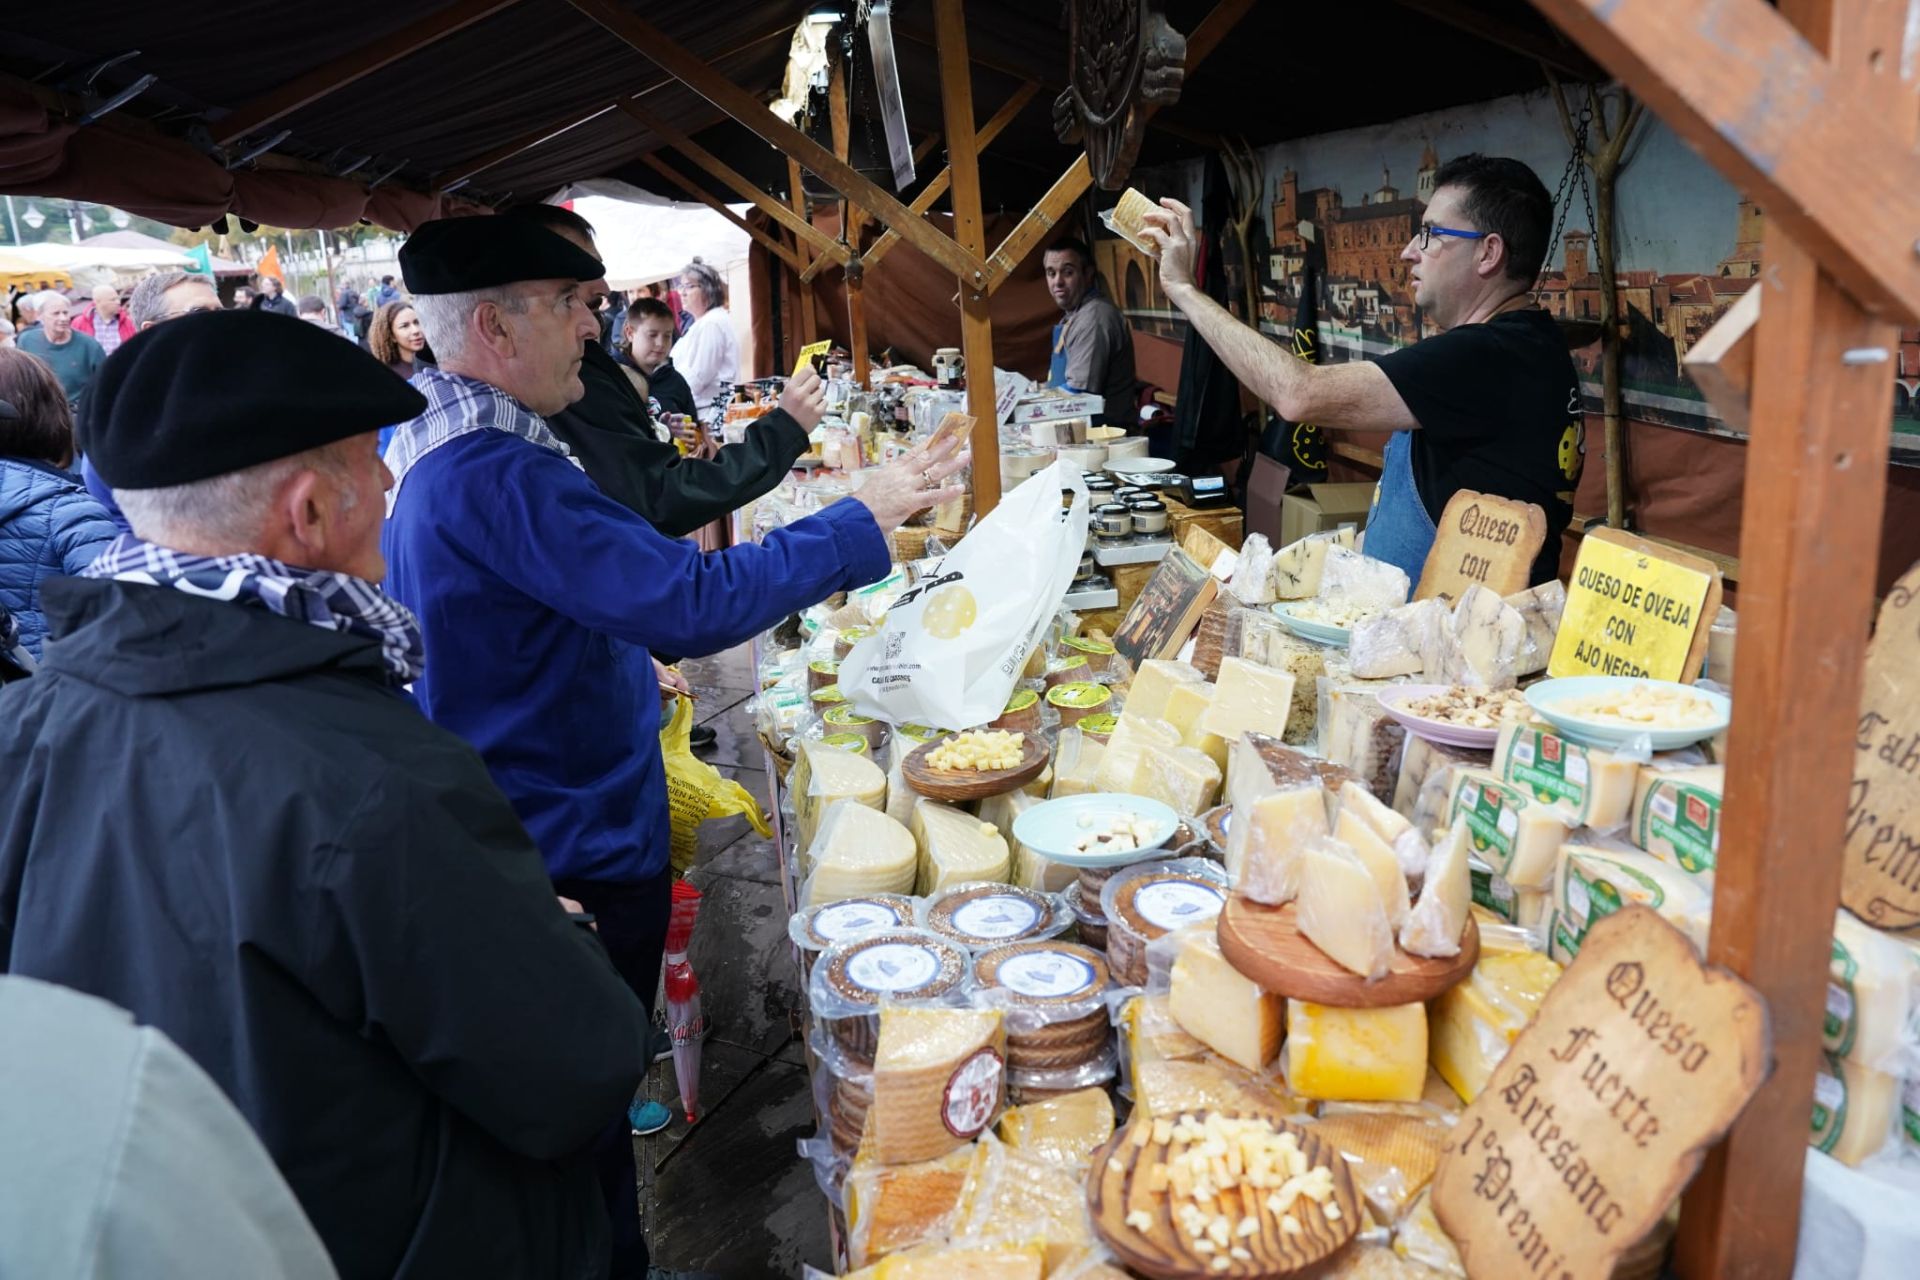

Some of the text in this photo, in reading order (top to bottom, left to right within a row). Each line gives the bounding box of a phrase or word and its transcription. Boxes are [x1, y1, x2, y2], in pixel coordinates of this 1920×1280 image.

[1459, 503, 1519, 546] Queso
[1459, 552, 1491, 583] con
[1578, 566, 1691, 630] QUESO DE OVEJA
[1574, 640, 1601, 668] AJO
[1605, 615, 1636, 646] CON
[1605, 960, 1711, 1074] Queso
[1549, 1026, 1660, 1150] Fuerte
[1500, 1063, 1624, 1236] Artesano
[1473, 1145, 1574, 1280] Premi
